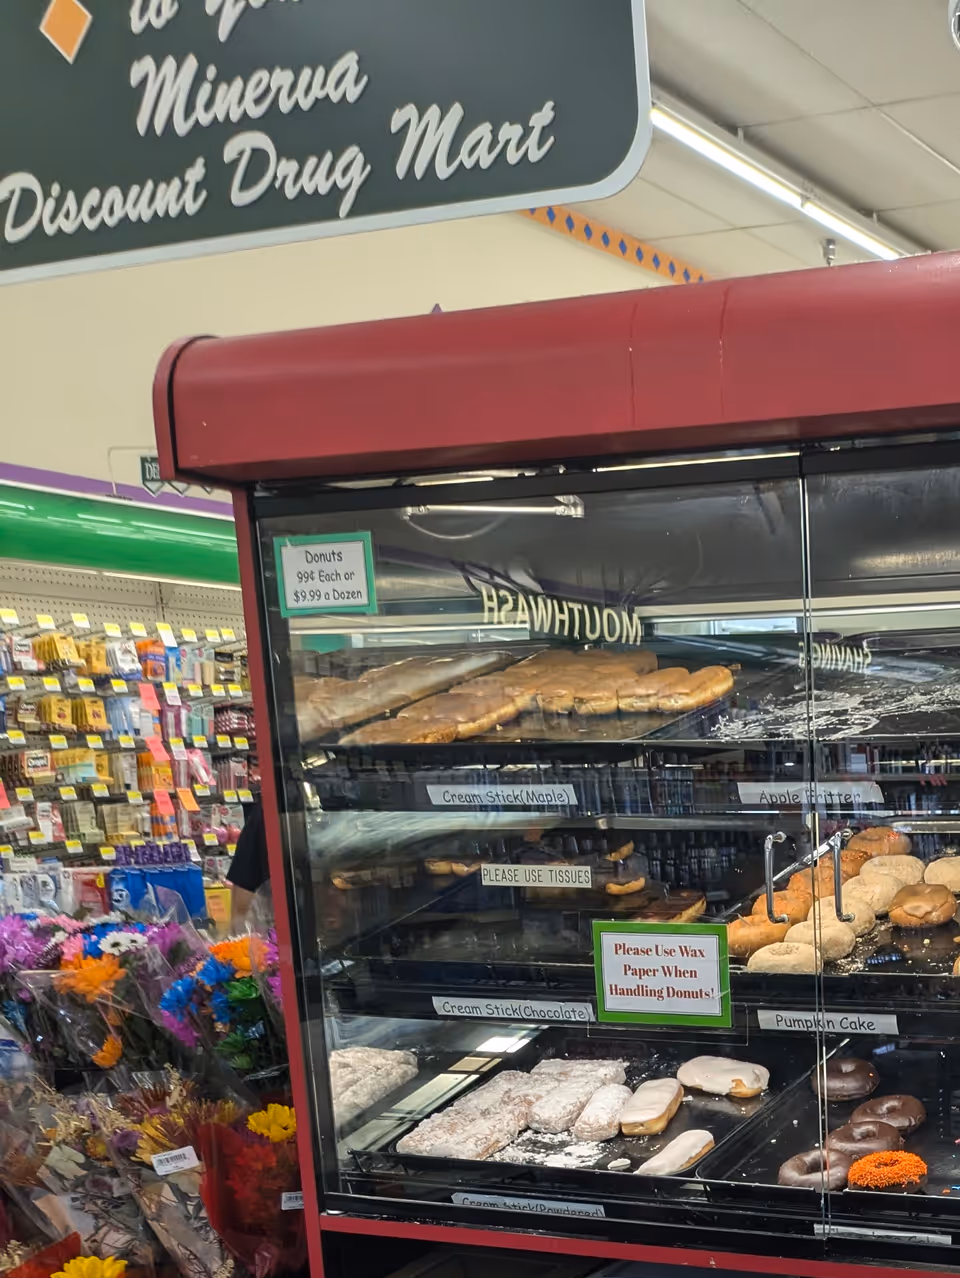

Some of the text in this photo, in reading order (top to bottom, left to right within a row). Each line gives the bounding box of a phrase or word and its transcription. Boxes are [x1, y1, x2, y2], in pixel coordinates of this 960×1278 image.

[130, 51, 368, 137] Minerva
[1, 100, 556, 243] Discount Drug Mart
[305, 550, 343, 564] Donuts
[296, 569, 355, 583] 99¢ Each or
[293, 588, 362, 604] $9.99 a Dozen
[442, 789, 570, 805] Cream Stick(Maple)
[759, 789, 801, 804] Apple
[483, 868, 590, 884] PLEASE USE TISSUES
[614, 943, 705, 958] Please Use Wax
[623, 964, 698, 980] Paper When
[609, 984, 714, 1001] Handling Donuts!
[442, 1001, 591, 1020] Cream Stick(Chocolate)
[775, 1014, 876, 1031] Pumpkin Cake
